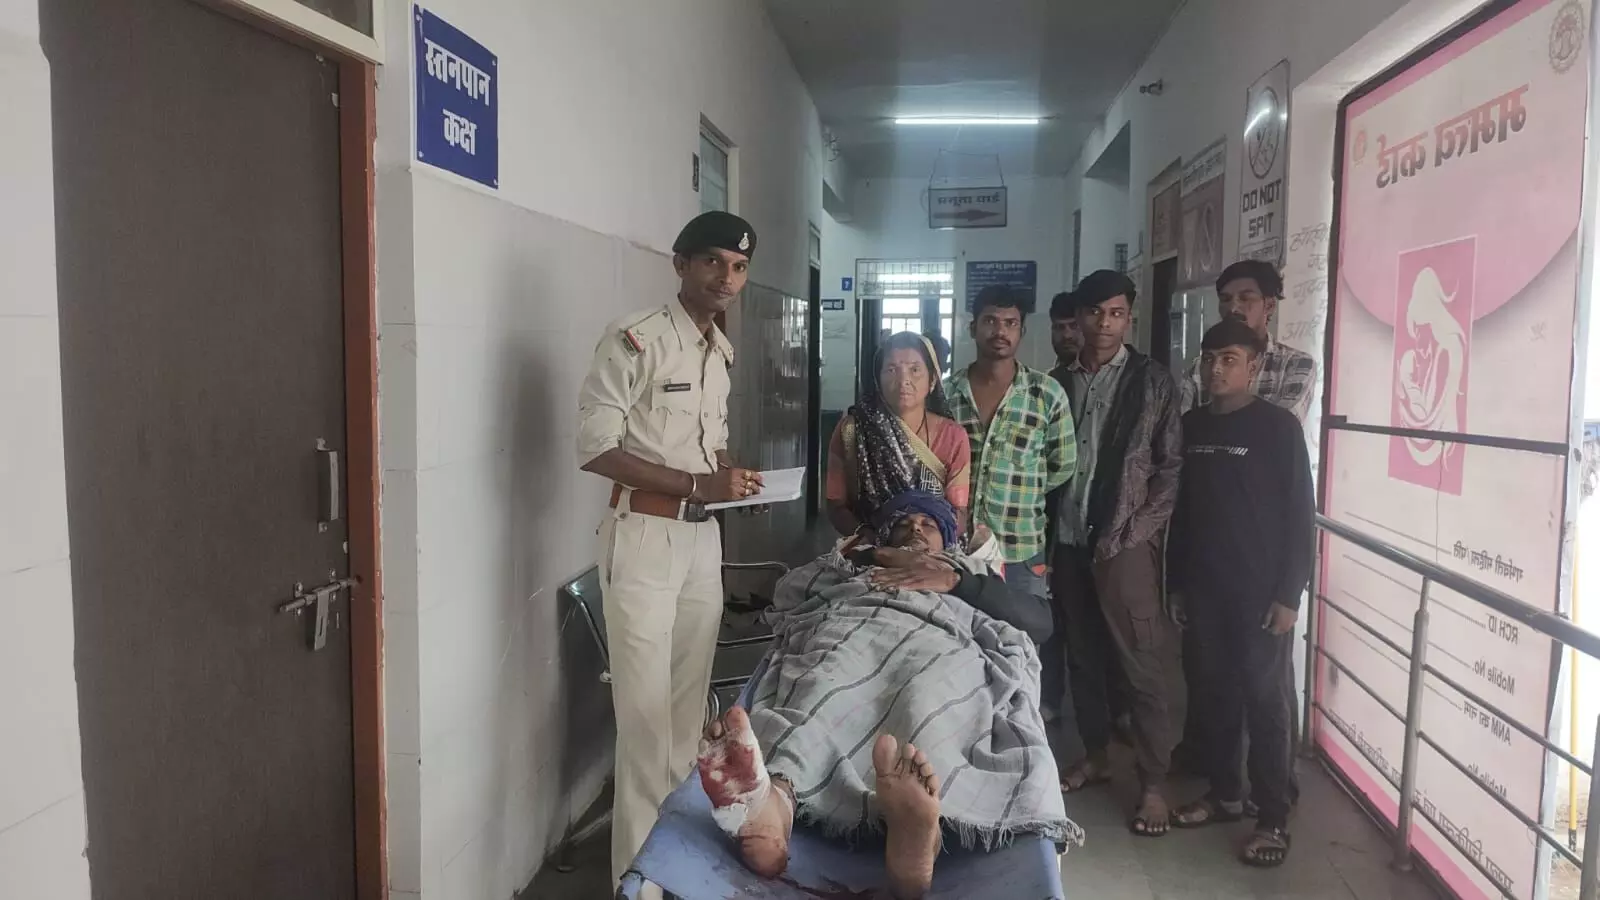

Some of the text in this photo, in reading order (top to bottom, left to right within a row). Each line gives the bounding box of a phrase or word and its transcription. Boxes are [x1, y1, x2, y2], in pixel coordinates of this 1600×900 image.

[424, 37, 491, 106] स्तनपान
[443, 108, 477, 156] कक्ष
[1242, 179, 1281, 213] DO NOT
[1248, 212, 1274, 238] SPIT
